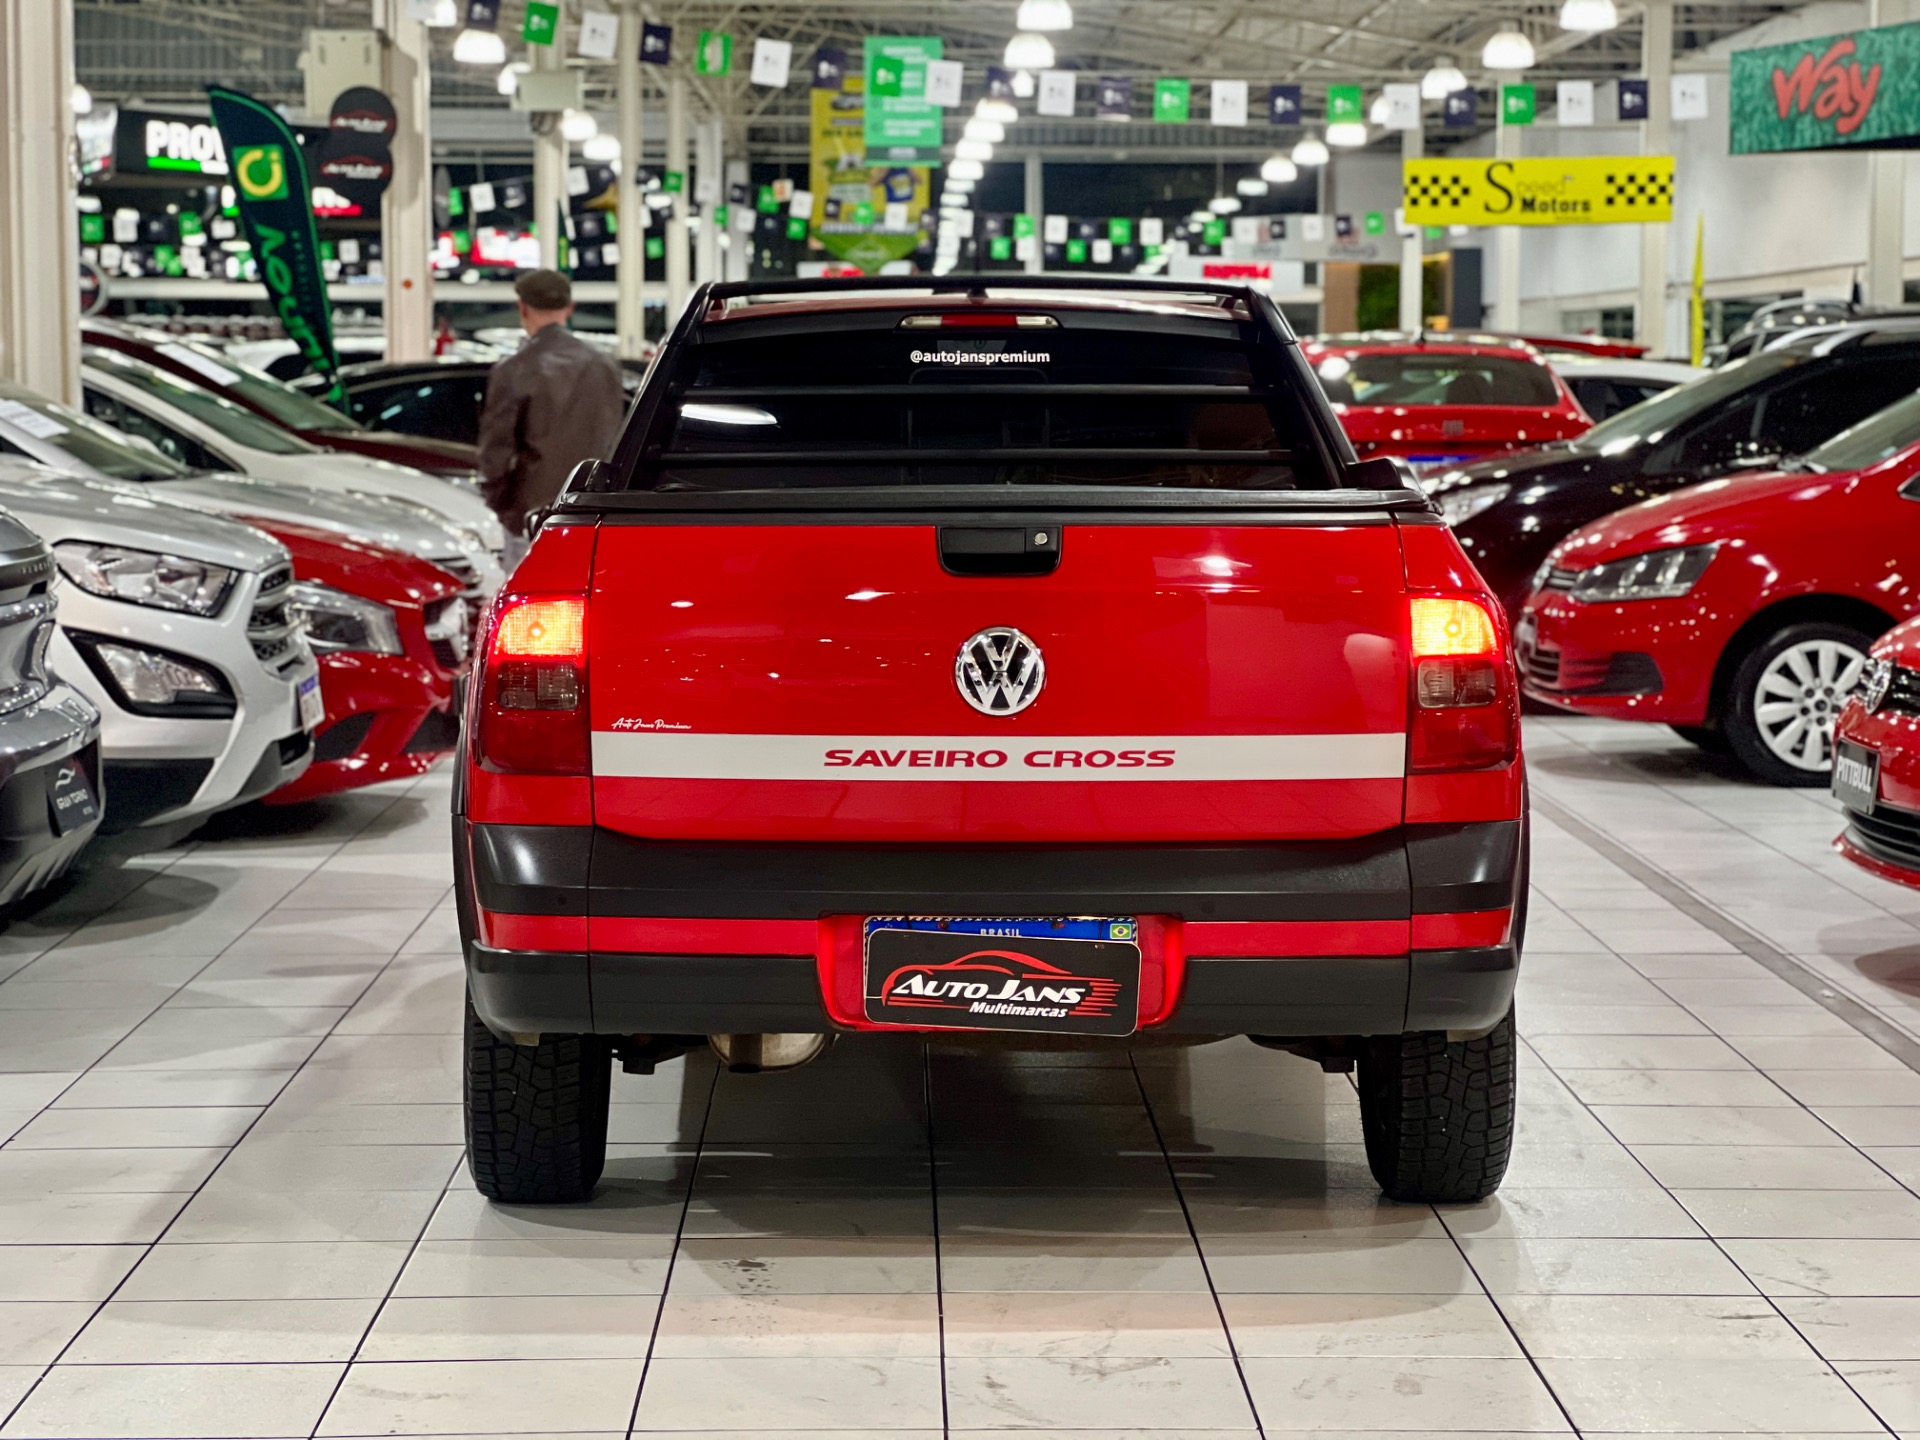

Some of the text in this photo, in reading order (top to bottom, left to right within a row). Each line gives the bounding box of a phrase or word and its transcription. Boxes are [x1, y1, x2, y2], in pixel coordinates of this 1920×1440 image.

[1772, 38, 1882, 134] Way
[1520, 196, 1592, 214] Motors
[910, 350, 1050, 365] @autojanspremium
[824, 749, 1176, 768] SAVEIRO CROSS
[980, 928, 1022, 937] BRASIL
[969, 1002, 1068, 1018] Multimarcas
